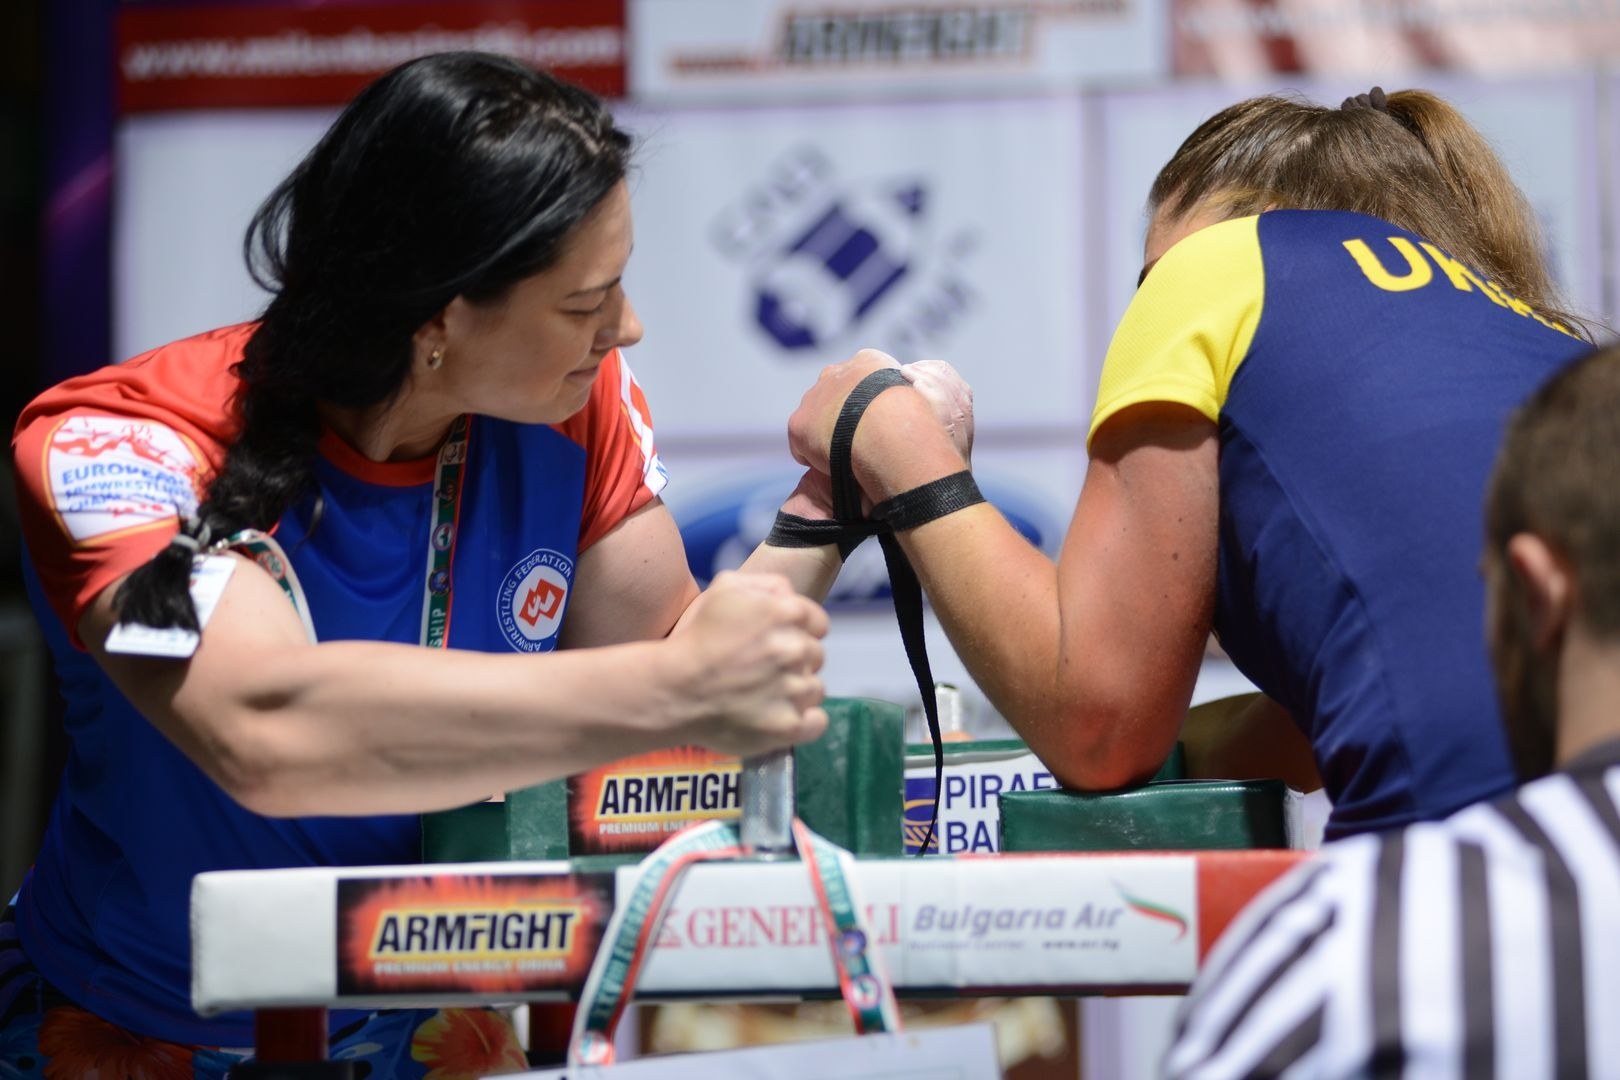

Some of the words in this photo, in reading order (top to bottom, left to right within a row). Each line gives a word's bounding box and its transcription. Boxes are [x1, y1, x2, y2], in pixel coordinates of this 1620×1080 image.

[514, 554, 573, 580] FEDERATION
[600, 773, 741, 815] ARMFIGH
[599, 822, 660, 834] PREMIUM
[377, 912, 574, 953] ARMFIGHT
